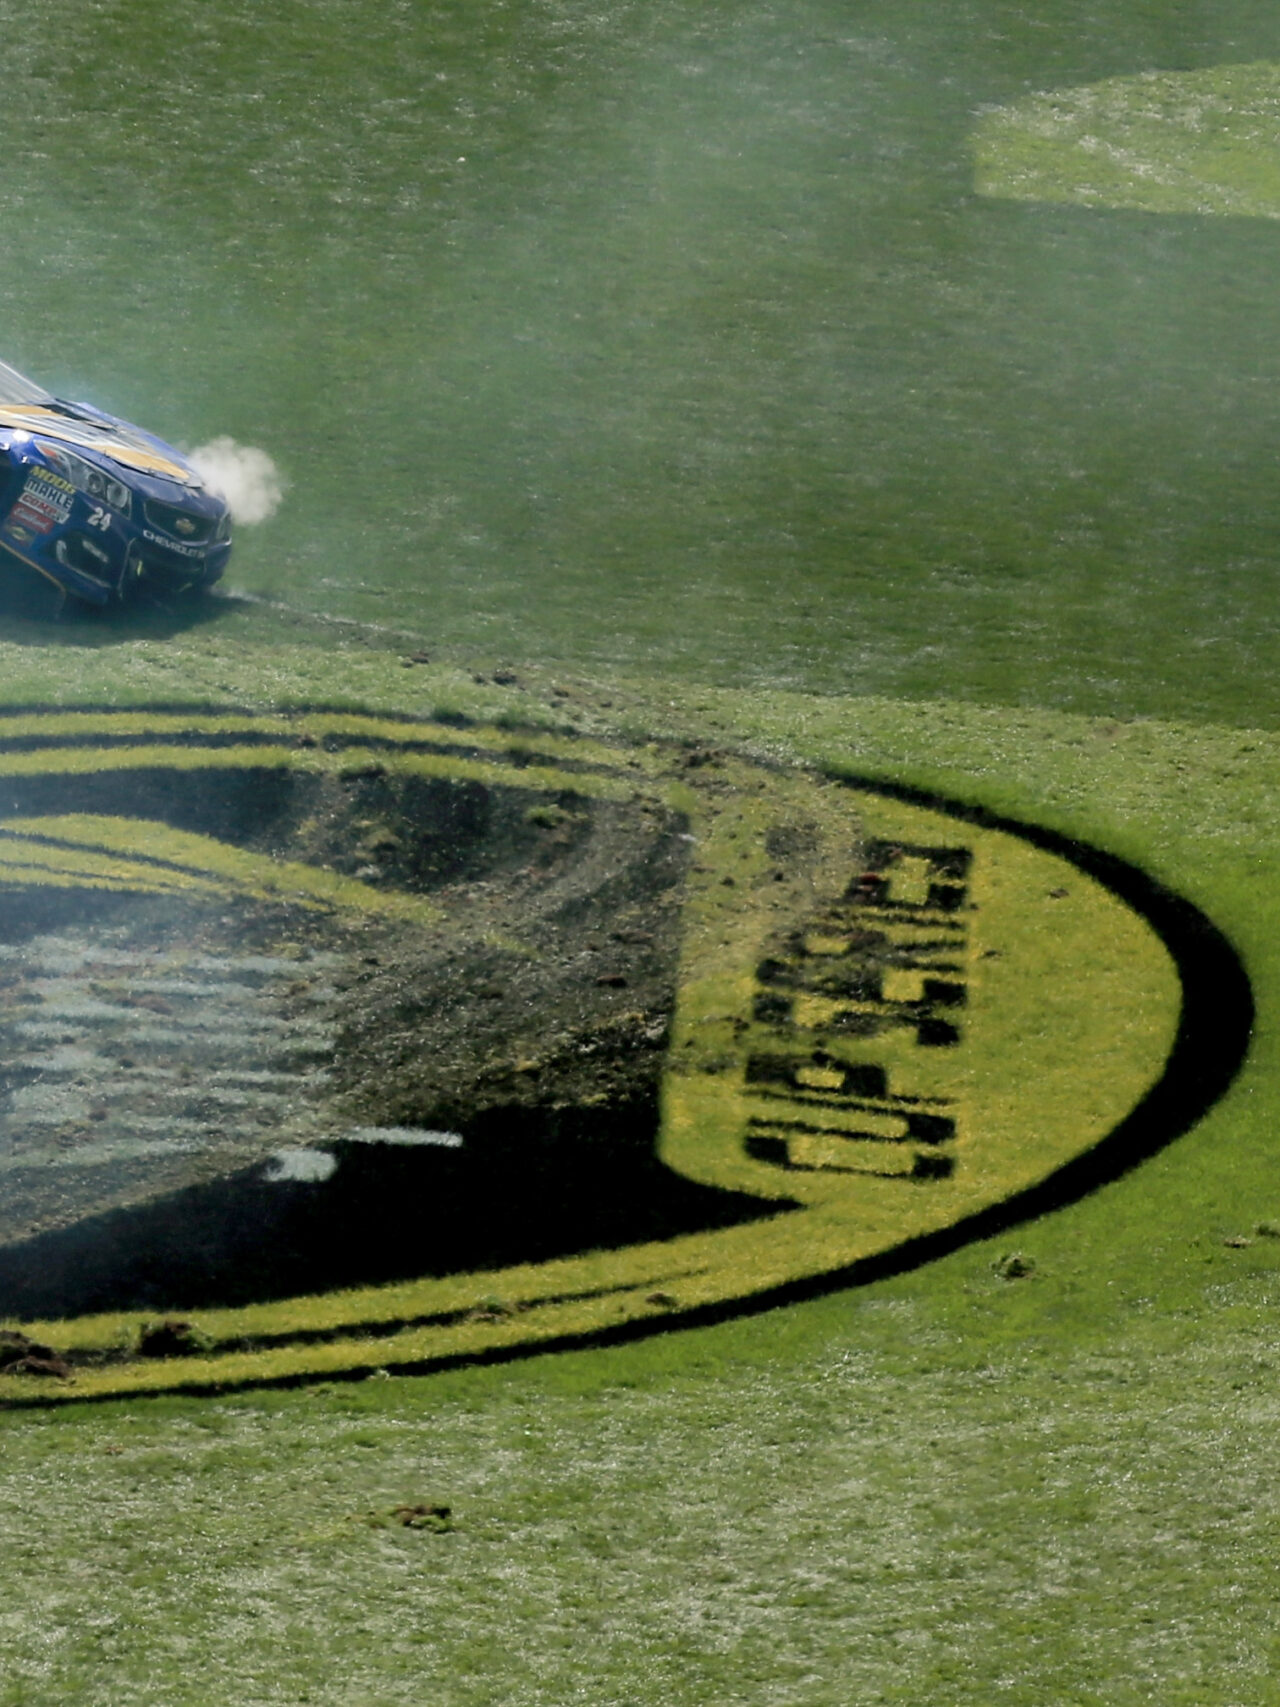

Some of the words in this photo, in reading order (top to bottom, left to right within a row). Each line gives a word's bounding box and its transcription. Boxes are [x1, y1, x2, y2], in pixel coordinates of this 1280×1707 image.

[25, 478, 74, 511] MAHLE
[87, 507, 112, 532] 24
[142, 529, 198, 558] CHEVROLET
[743, 1045, 957, 1182] CUP
